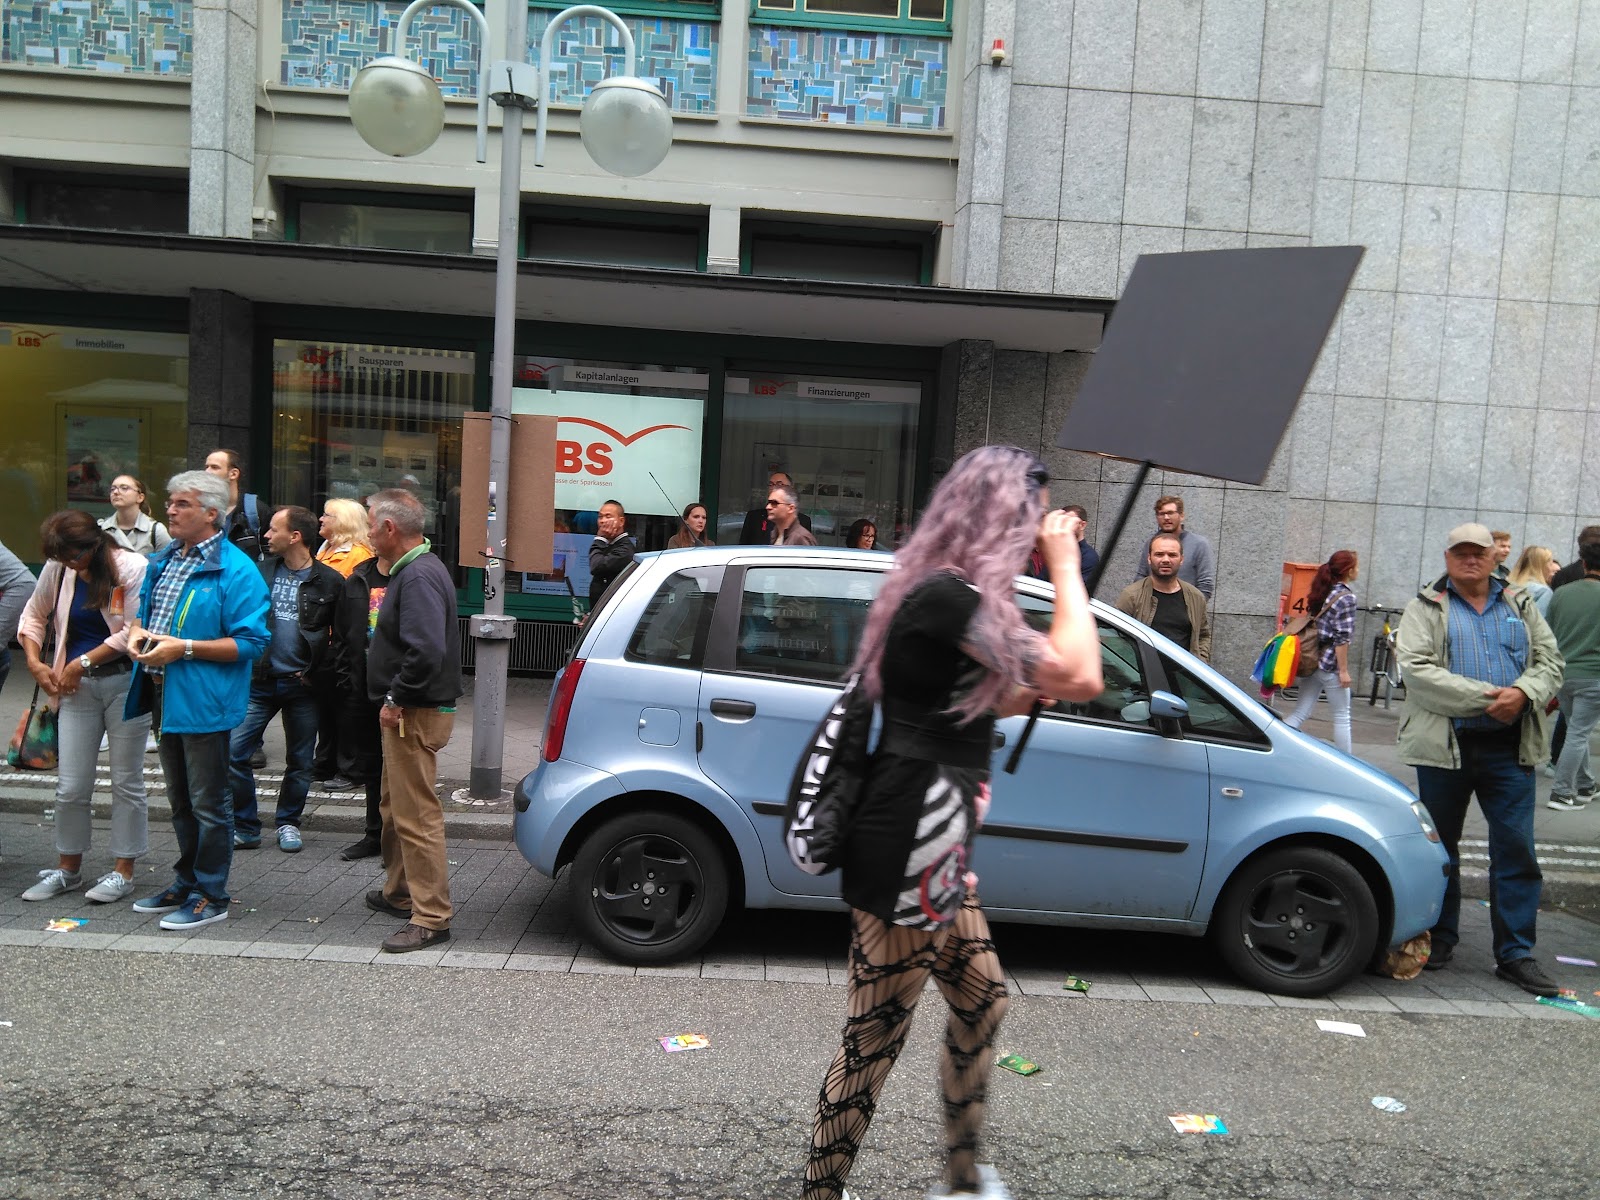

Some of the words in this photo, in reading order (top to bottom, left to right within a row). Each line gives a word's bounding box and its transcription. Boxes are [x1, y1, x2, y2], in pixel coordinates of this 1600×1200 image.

[18, 337, 40, 347] LBS
[75, 338, 125, 350] Immobilien
[358, 356, 404, 368] Bausparen
[575, 370, 639, 385] Kapitalanlagen
[754, 385, 777, 396] LBS
[807, 386, 870, 399] Finanzierungen
[555, 439, 614, 477] BS
[568, 477, 579, 485] der
[580, 478, 613, 488] Sparkassen
[274, 577, 304, 586] GINE
